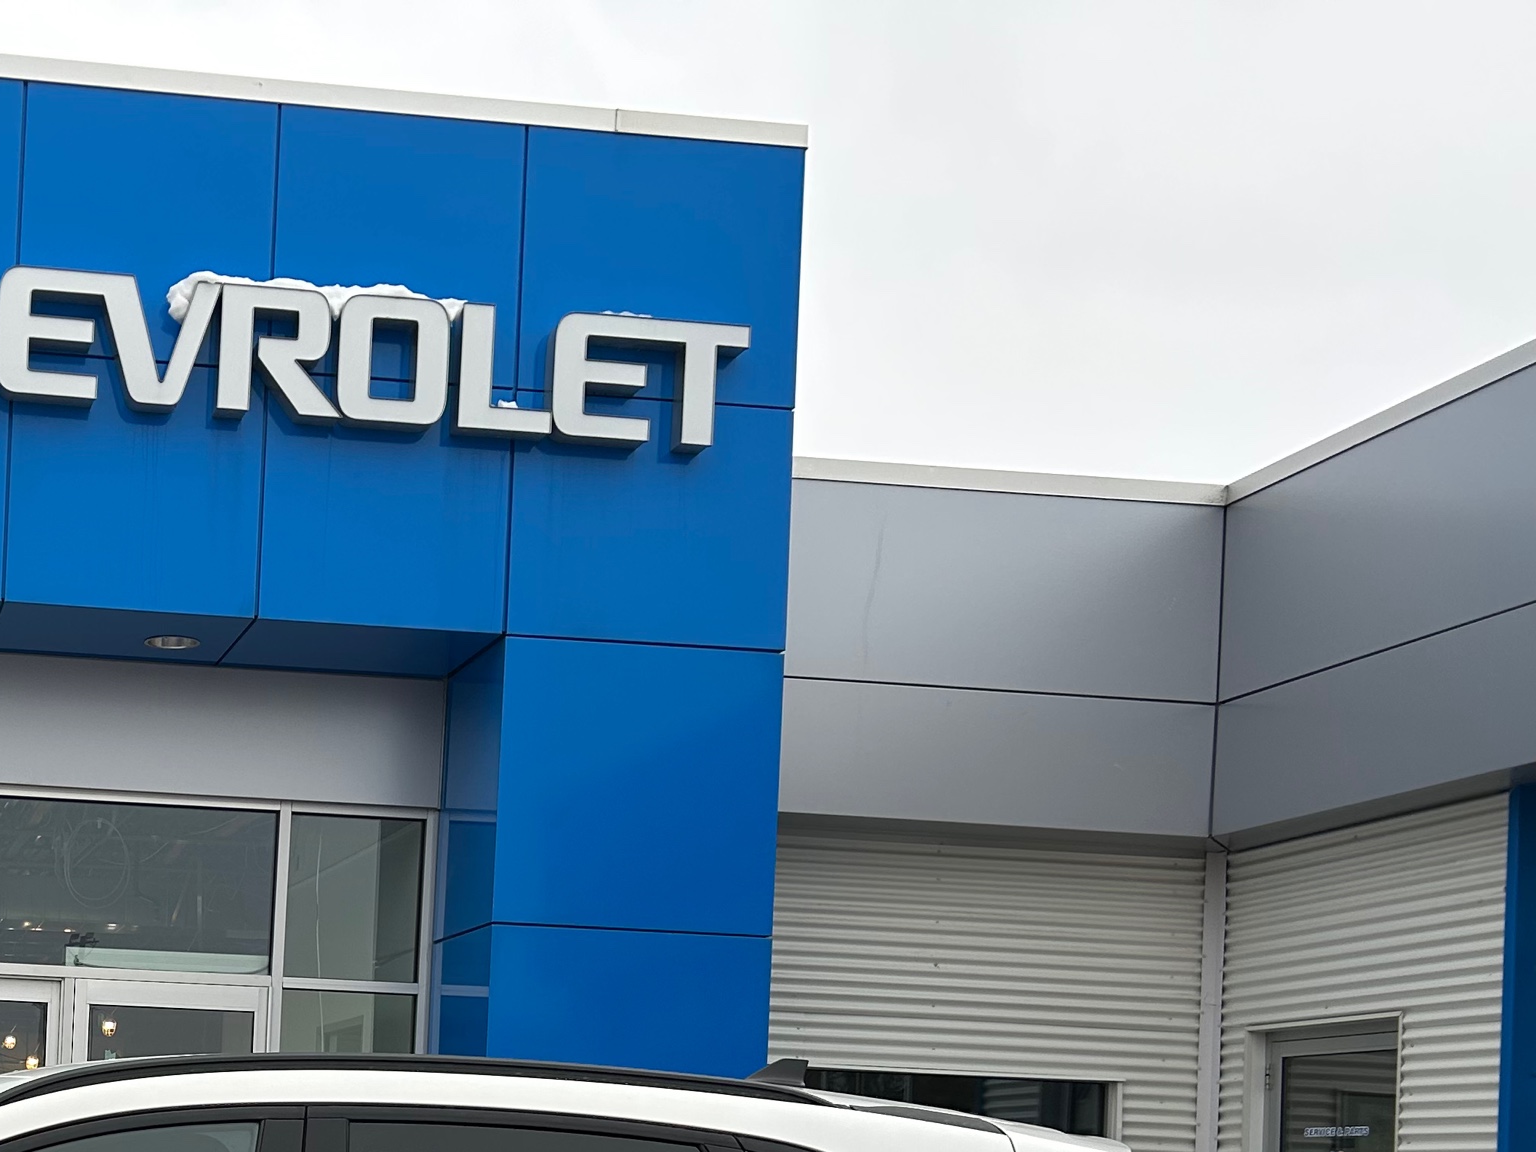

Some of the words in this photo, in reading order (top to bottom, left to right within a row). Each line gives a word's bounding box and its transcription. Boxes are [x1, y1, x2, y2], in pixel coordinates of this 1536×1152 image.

[1304, 1127, 1336, 1137] SERVICE
[1337, 1127, 1344, 1136] &
[1344, 1126, 1369, 1136] PARTS
